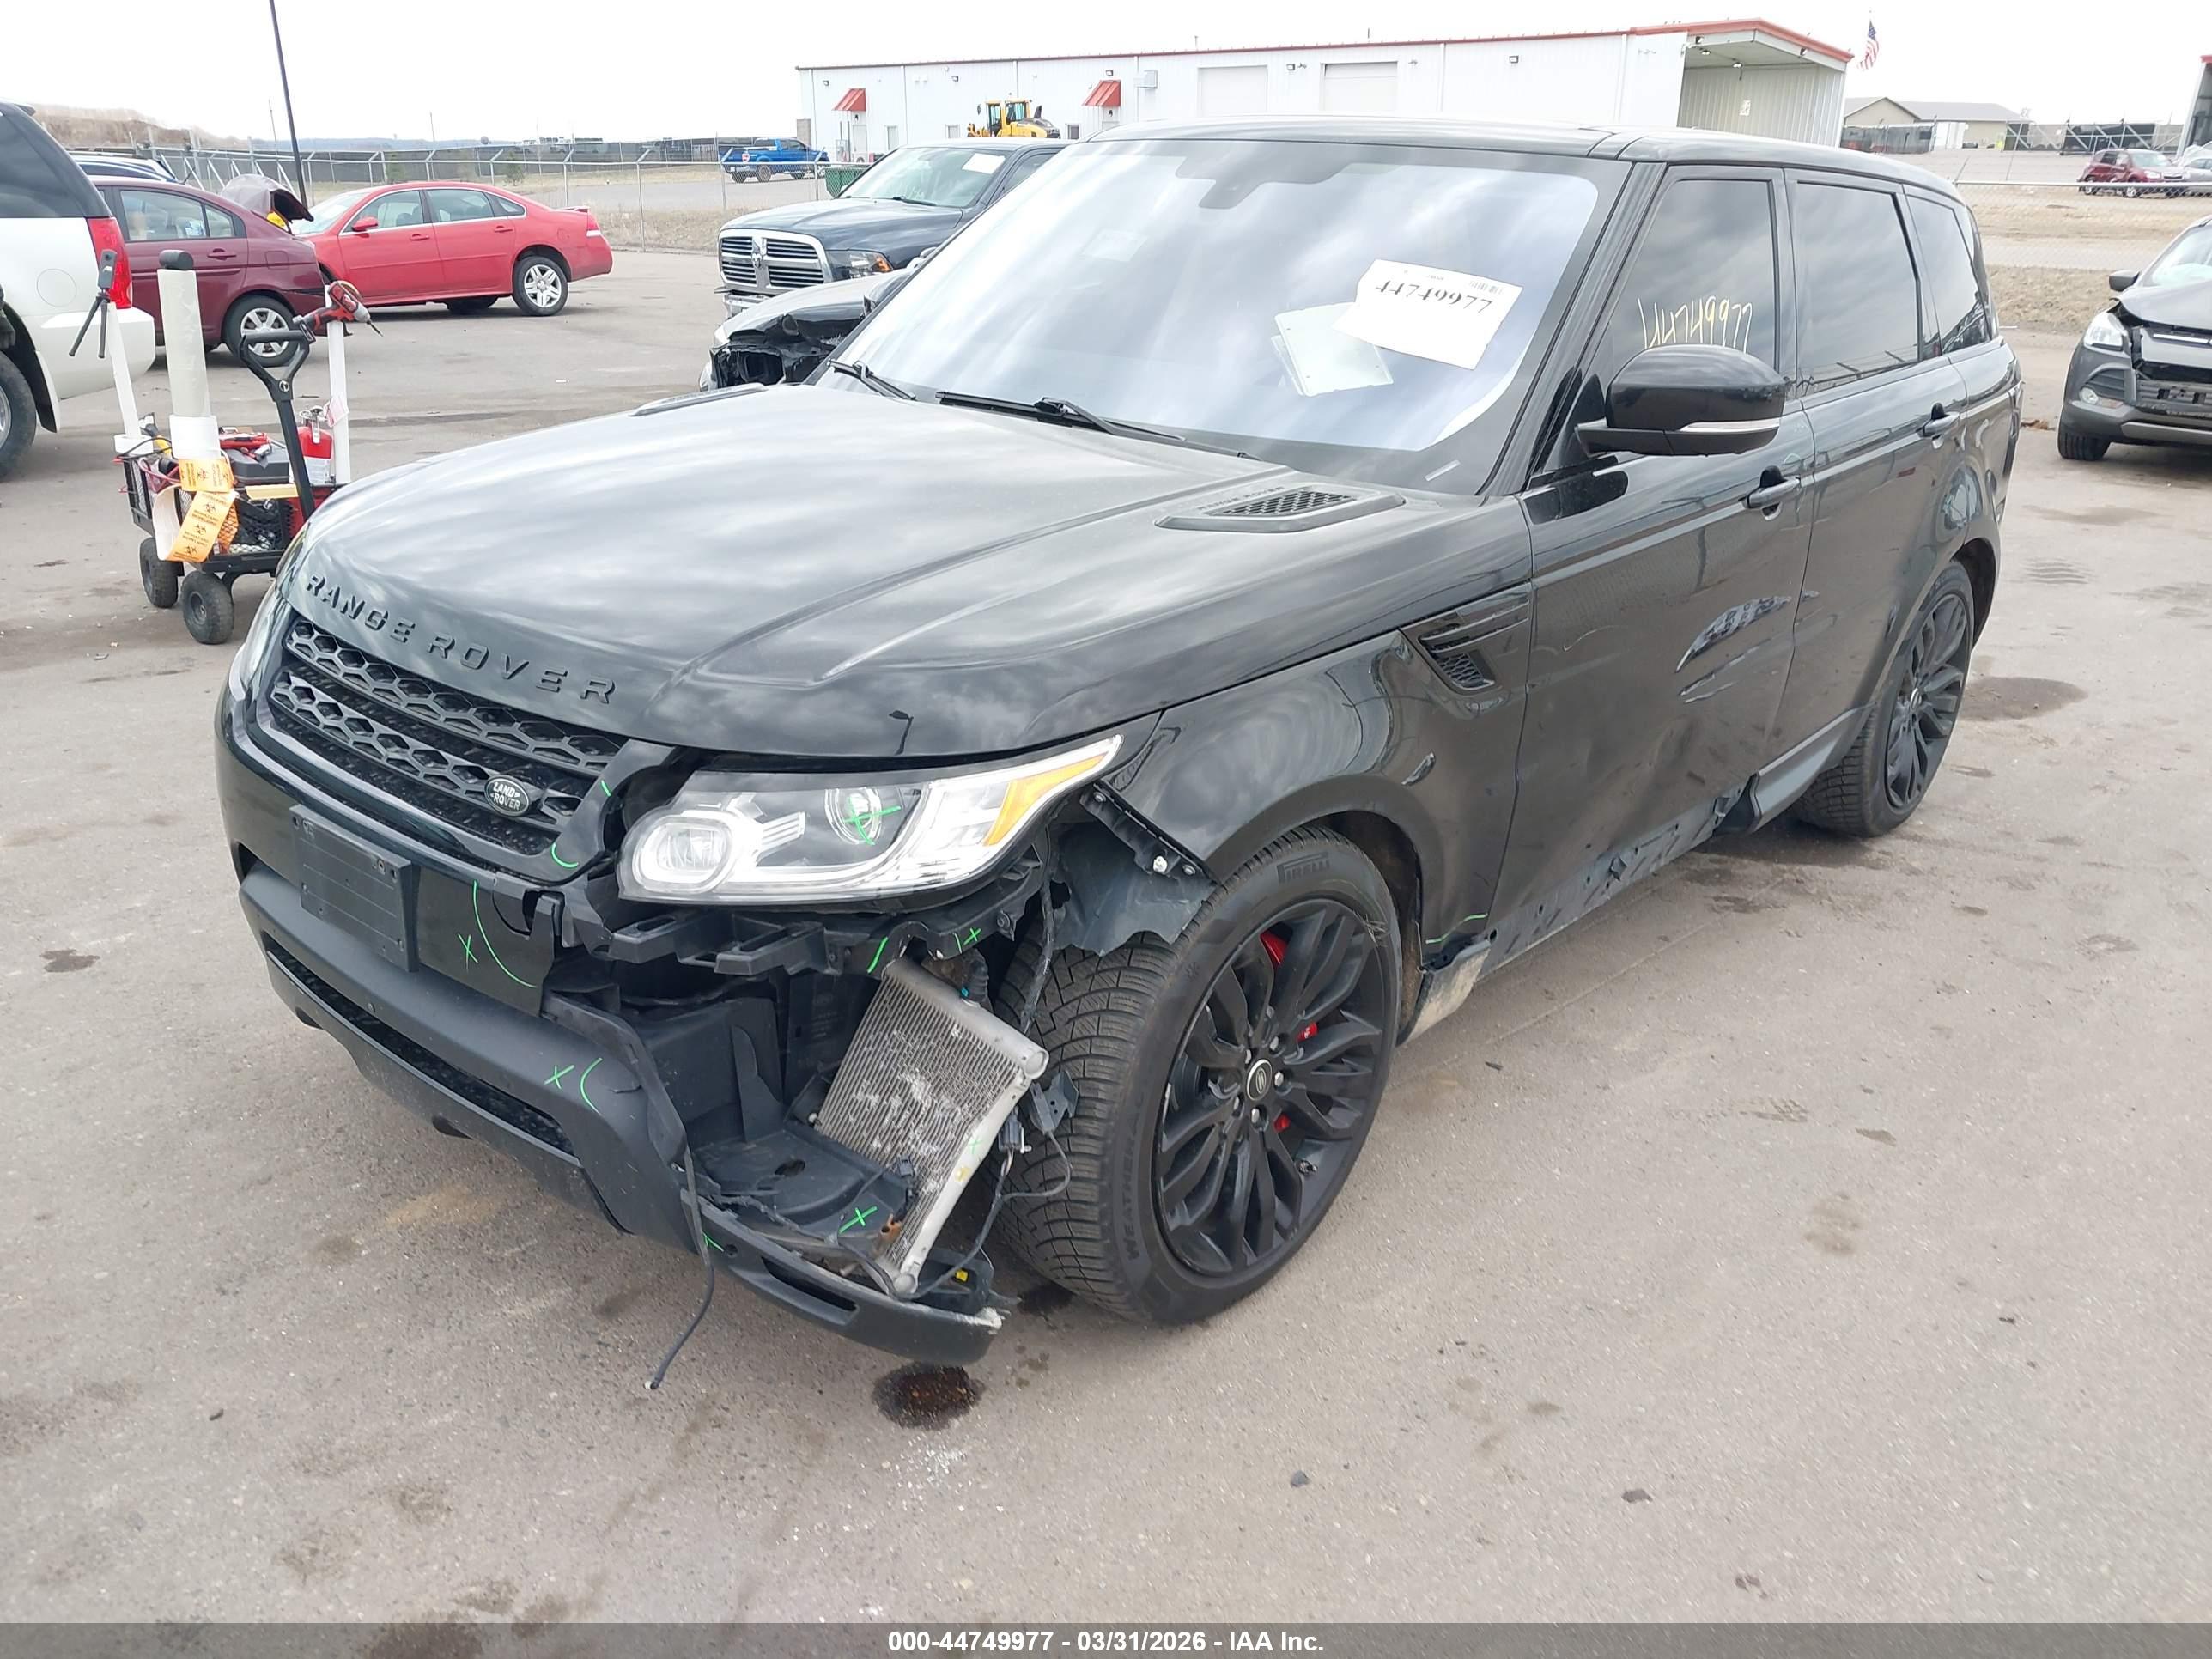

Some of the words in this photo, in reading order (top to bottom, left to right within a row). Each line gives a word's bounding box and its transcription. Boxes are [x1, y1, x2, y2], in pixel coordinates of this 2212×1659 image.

[1376, 280, 1494, 313] 44749977
[1637, 295, 1753, 354] 44749977
[307, 574, 416, 644] RANGE
[427, 632, 616, 705] ROVER
[493, 781, 516, 798] LAND
[493, 792, 522, 811] ROVER
